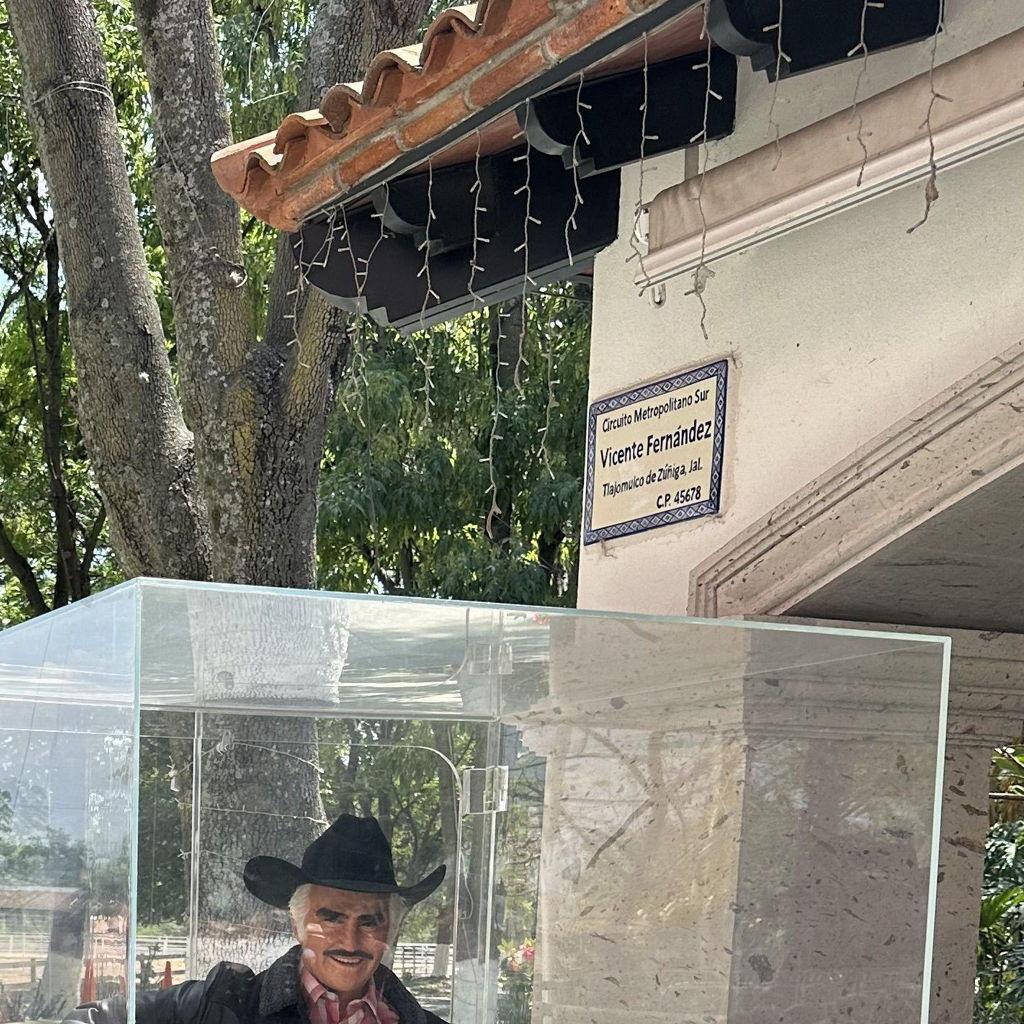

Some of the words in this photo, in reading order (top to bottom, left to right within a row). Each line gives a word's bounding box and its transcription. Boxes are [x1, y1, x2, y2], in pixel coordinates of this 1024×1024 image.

[602, 415, 632, 433] Circuito
[633, 395, 693, 423] Metropolitano
[694, 389, 710, 404] Sur
[600, 441, 644, 468] Vicente
[646, 419, 712, 456] Fernández
[602, 475, 645, 498] Tlajomulco
[645, 470, 656, 485] de
[657, 463, 687, 482] Zúñiga,
[688, 457, 703, 474] Jal.
[656, 493, 672, 509] C.P.
[673, 485, 702, 505] 45678
